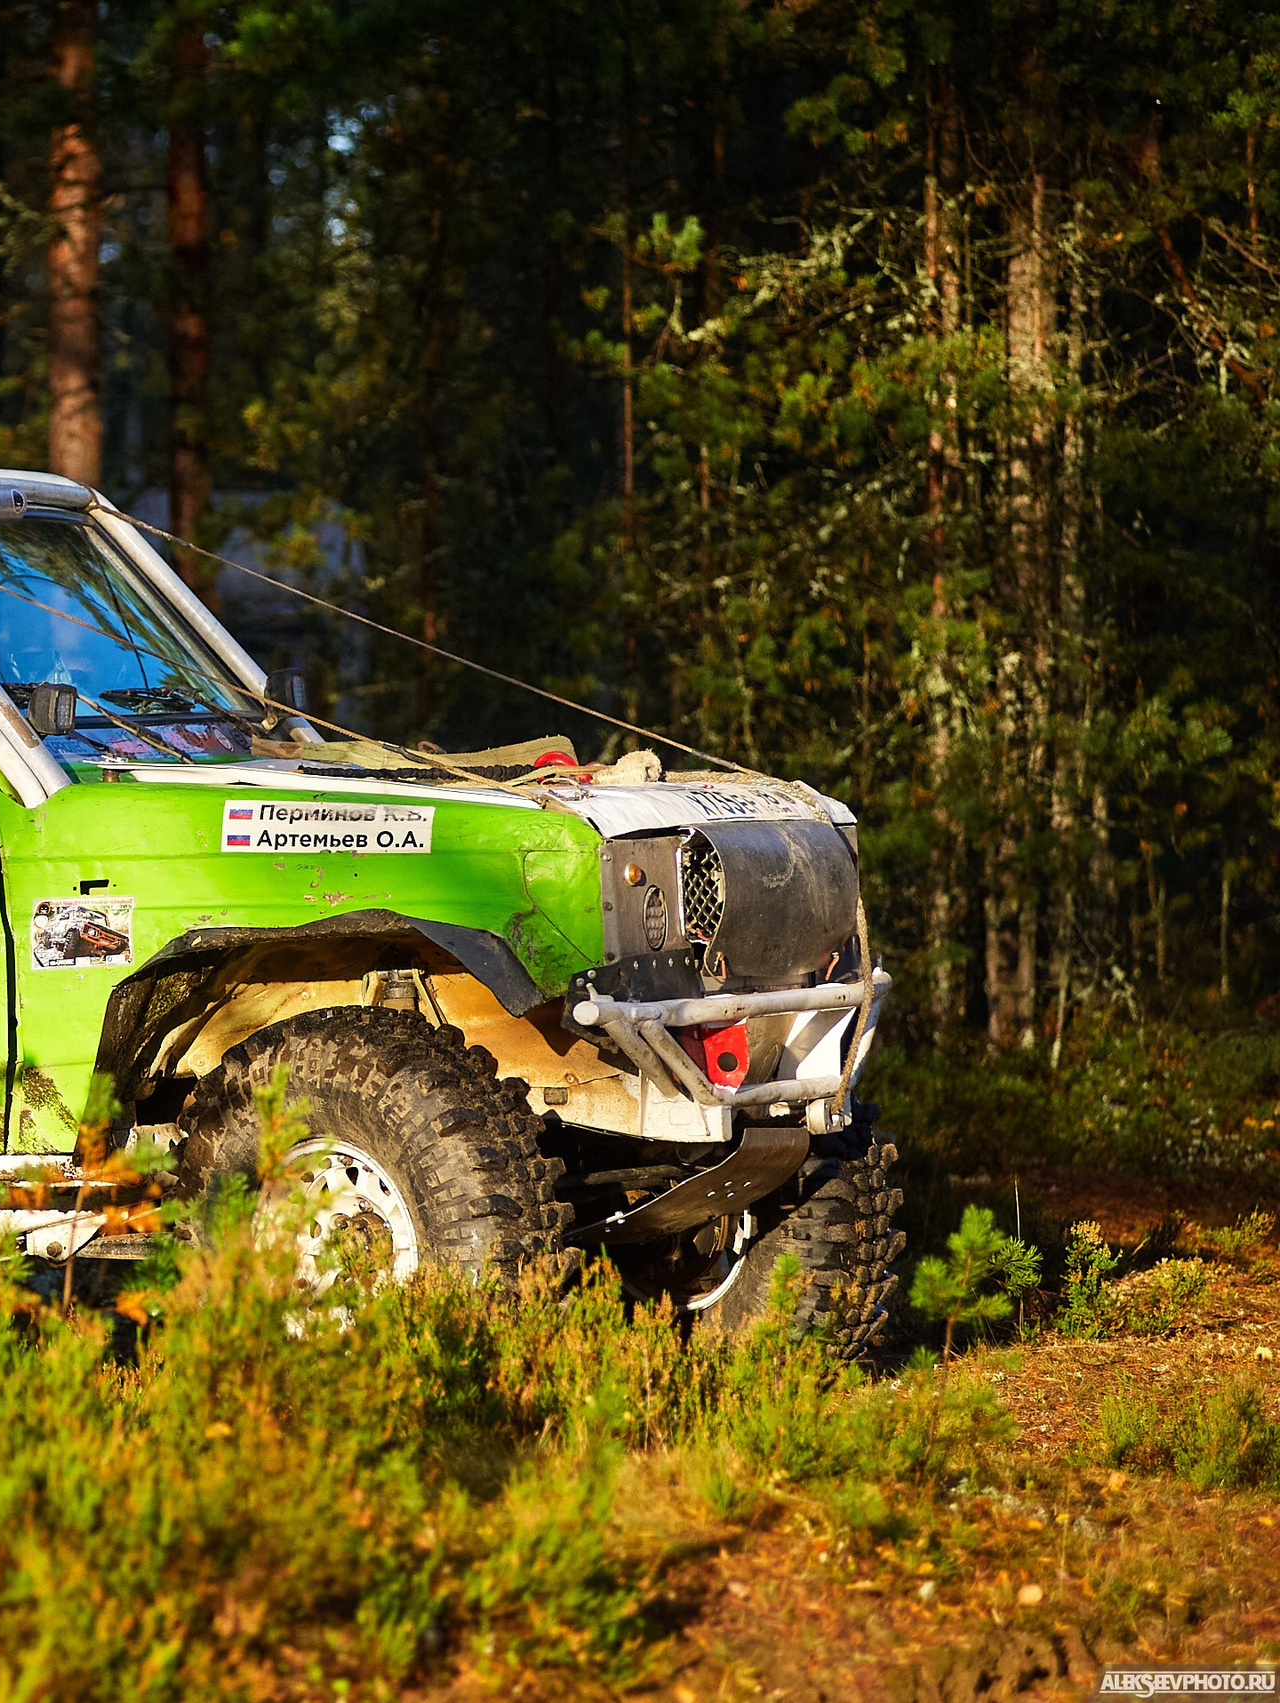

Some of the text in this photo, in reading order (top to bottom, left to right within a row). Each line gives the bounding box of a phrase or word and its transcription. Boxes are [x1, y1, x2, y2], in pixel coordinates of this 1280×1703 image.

[259, 804, 376, 824] Перминов
[257, 829, 424, 850] Артемьев О.А.
